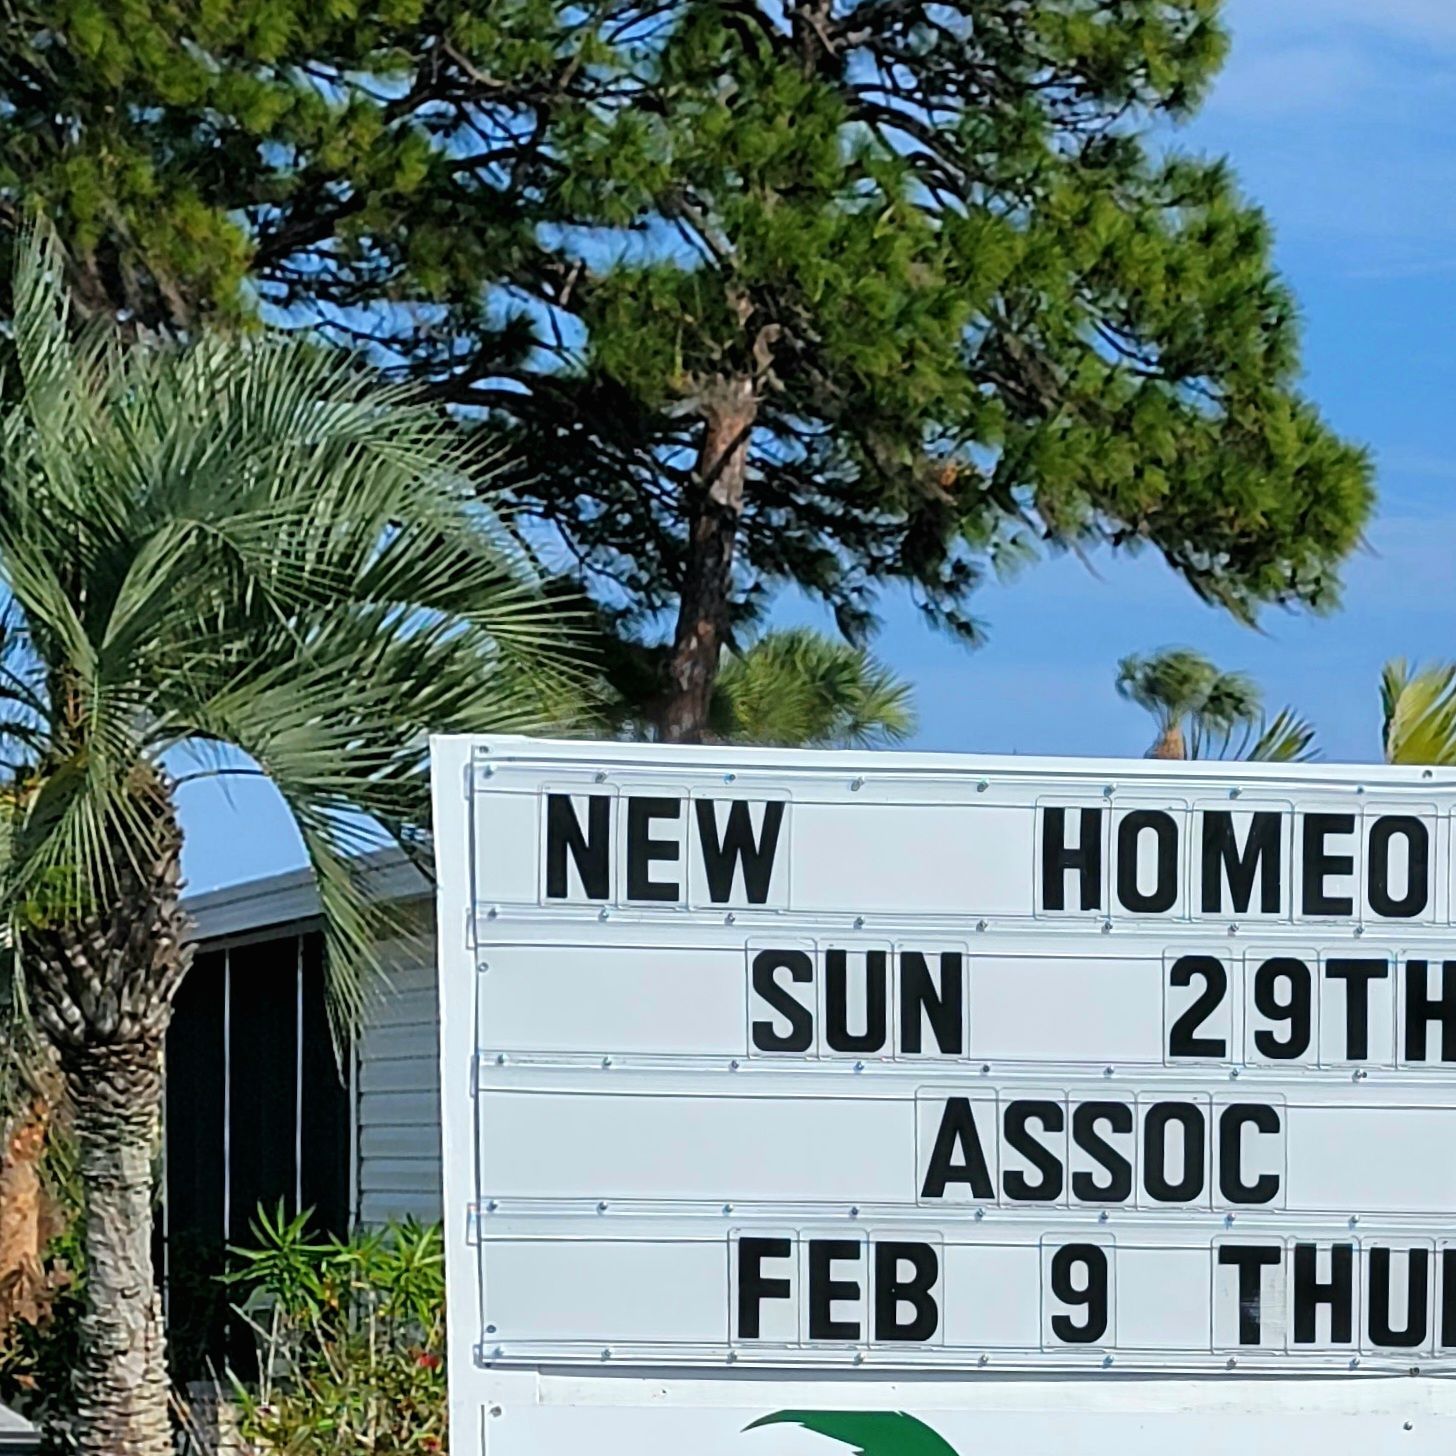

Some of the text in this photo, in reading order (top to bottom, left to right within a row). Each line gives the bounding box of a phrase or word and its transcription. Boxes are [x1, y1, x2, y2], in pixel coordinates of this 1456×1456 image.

[547, 794, 784, 903] NEW
[753, 950, 962, 1054] SUN
[921, 1098, 1280, 1203] ASSOC
[739, 1238, 938, 1341] FEB
[1052, 1244, 1107, 1343] 9
